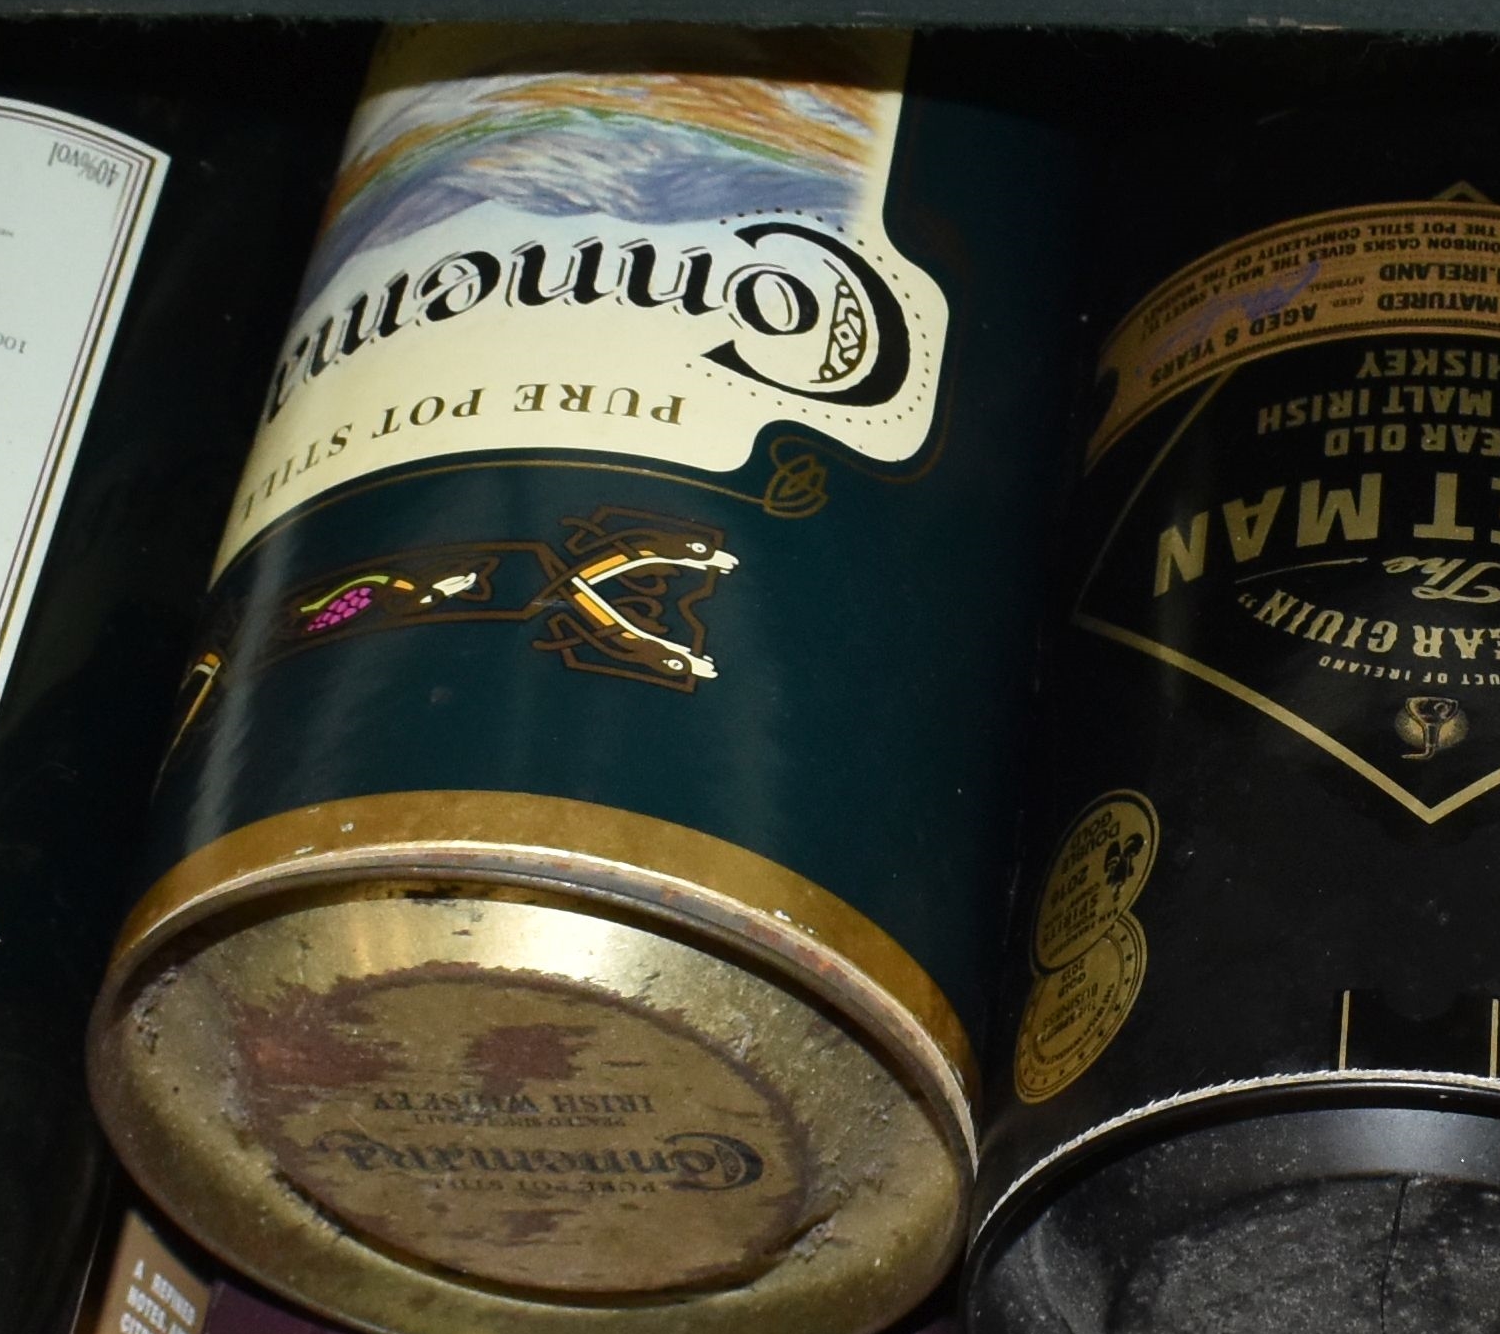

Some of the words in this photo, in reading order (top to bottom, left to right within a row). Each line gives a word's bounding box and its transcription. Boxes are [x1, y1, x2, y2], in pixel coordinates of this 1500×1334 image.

[1248, 302, 1319, 337] AGED
[1376, 291, 1498, 315] MATURED
[1224, 326, 1241, 348] 8
[371, 387, 486, 440] POT
[513, 382, 687, 427] PURE
[1256, 387, 1371, 436] IRISH
[1380, 385, 1494, 417] MALT
[1324, 423, 1408, 458] OLD
[1151, 472, 1384, 599] MAN
[1315, 653, 1413, 683] IRELAND
[1420, 670, 1449, 686] OF
[551, 1093, 656, 1115] IRISH
